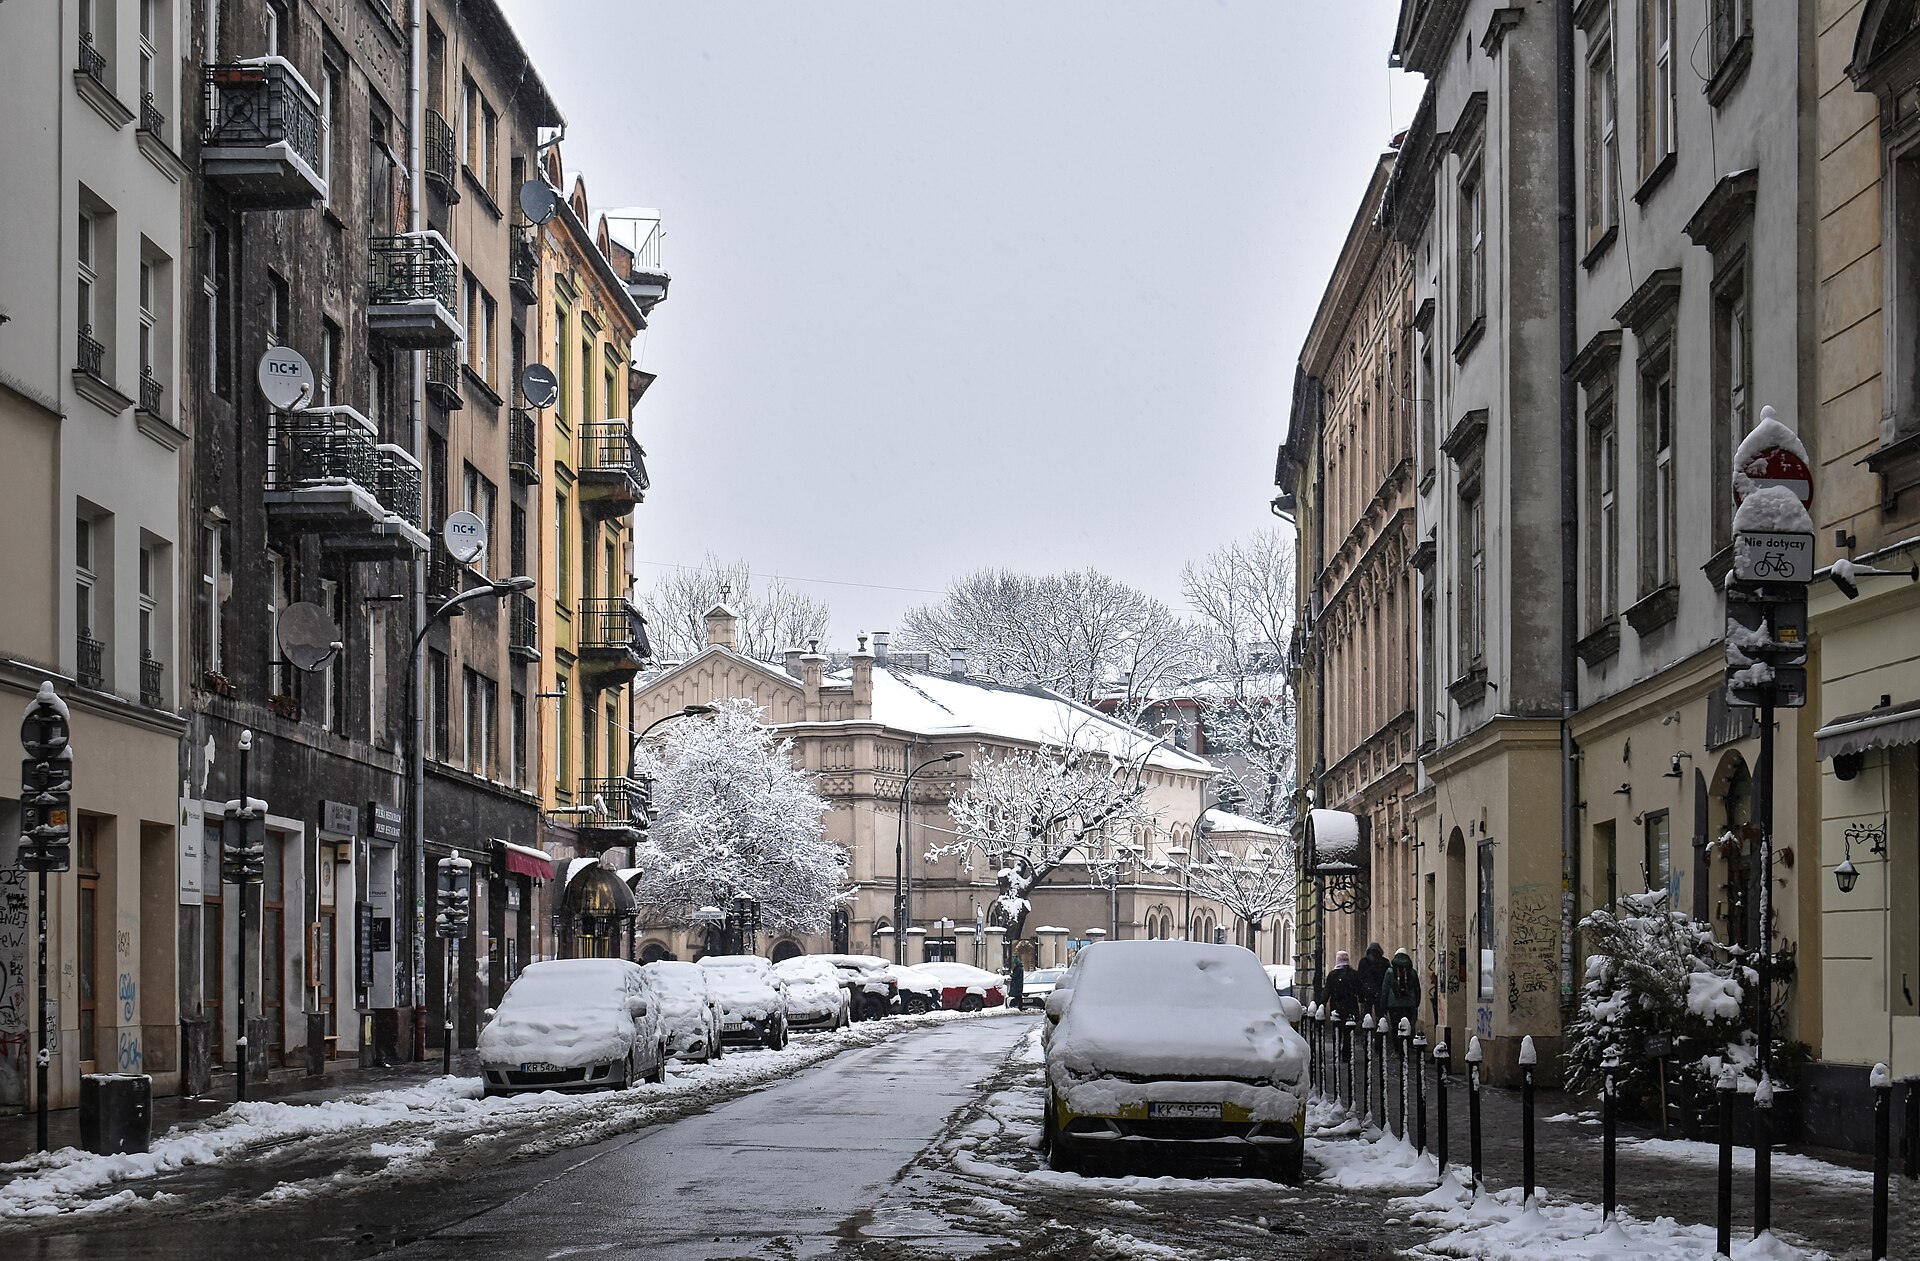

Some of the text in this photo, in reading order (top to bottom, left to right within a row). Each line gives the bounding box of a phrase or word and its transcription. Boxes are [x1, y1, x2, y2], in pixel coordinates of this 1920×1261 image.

[270, 362, 299, 374] nc+
[453, 524, 476, 534] nc+
[1744, 537, 1806, 551] Nie dotyczy
[1158, 1104, 1173, 1116] KK
